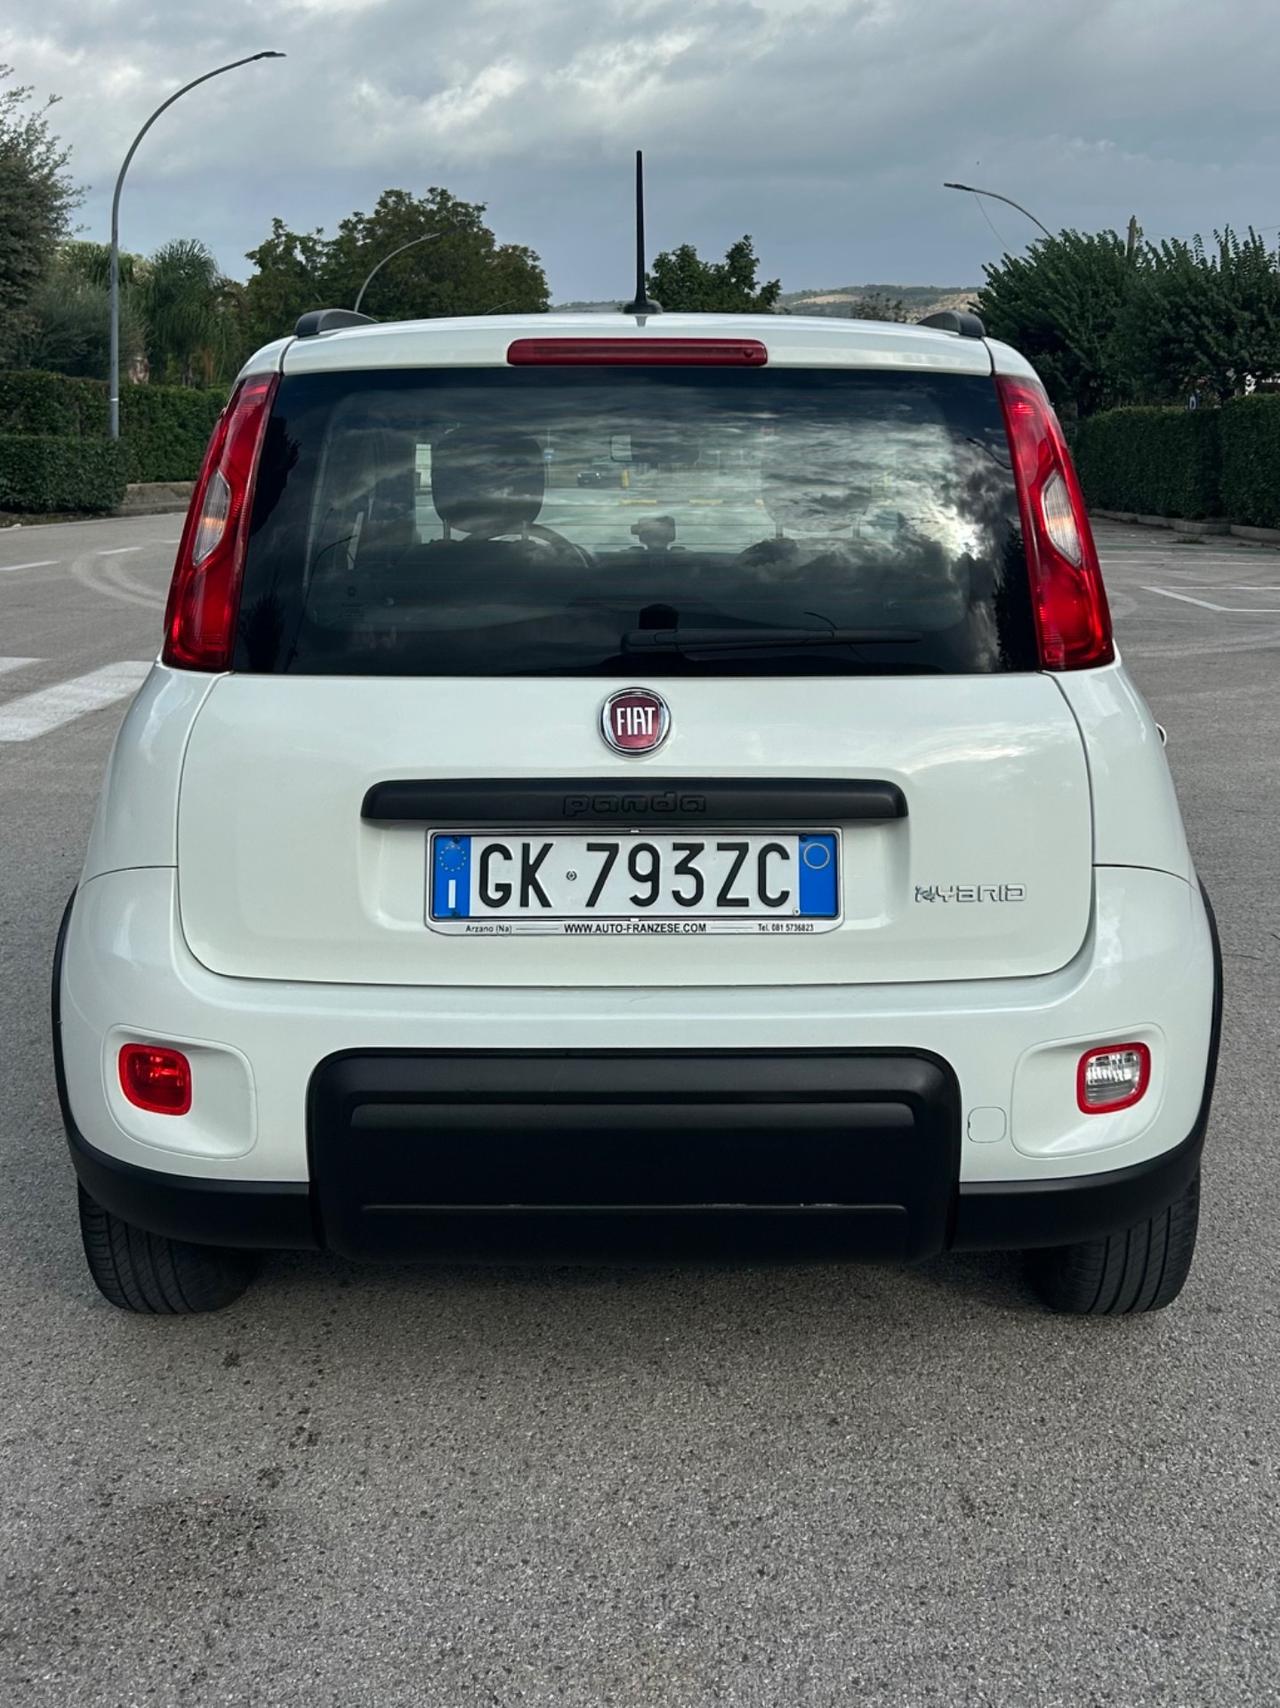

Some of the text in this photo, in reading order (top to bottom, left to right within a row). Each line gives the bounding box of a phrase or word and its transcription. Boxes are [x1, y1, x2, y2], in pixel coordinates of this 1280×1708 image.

[616, 707, 656, 736] FIAT
[563, 791, 706, 817] panda
[479, 842, 791, 908] GK 793ZC
[914, 883, 1026, 903] HYBRID
[465, 924, 494, 933] Arzano
[564, 923, 707, 933] WWW.AUTO-FRANZESE.COM
